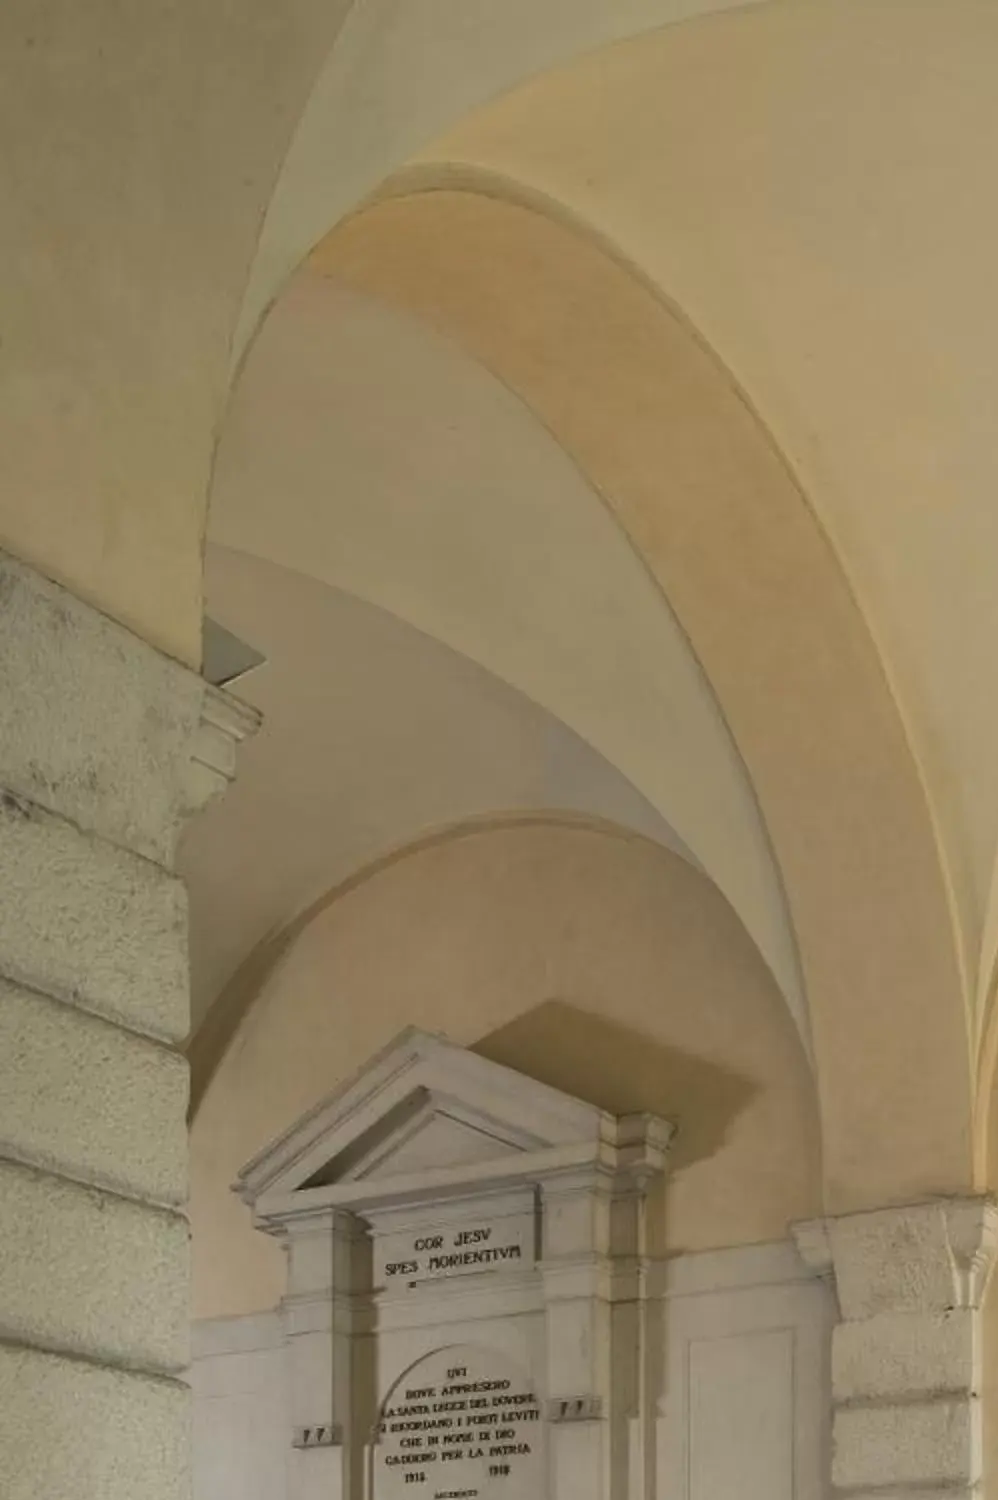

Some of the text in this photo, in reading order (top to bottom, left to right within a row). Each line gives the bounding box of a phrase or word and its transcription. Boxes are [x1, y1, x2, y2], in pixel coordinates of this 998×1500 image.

[414, 1228, 492, 1251] COR JESV
[385, 1245, 521, 1276] SPES MORIENTIVM
[406, 1388, 436, 1400] DOVE
[398, 1403, 430, 1417] SANTA
[470, 1398, 488, 1409] DEL
[457, 1418, 461, 1427] I
[501, 1410, 539, 1422] LEVITI
[400, 1437, 422, 1448] CHE
[443, 1432, 474, 1444] NOME
[495, 1429, 515, 1439] DIO
[442, 1449, 463, 1461] PER
[468, 1448, 484, 1458] LA
[489, 1443, 531, 1457] PATRIA
